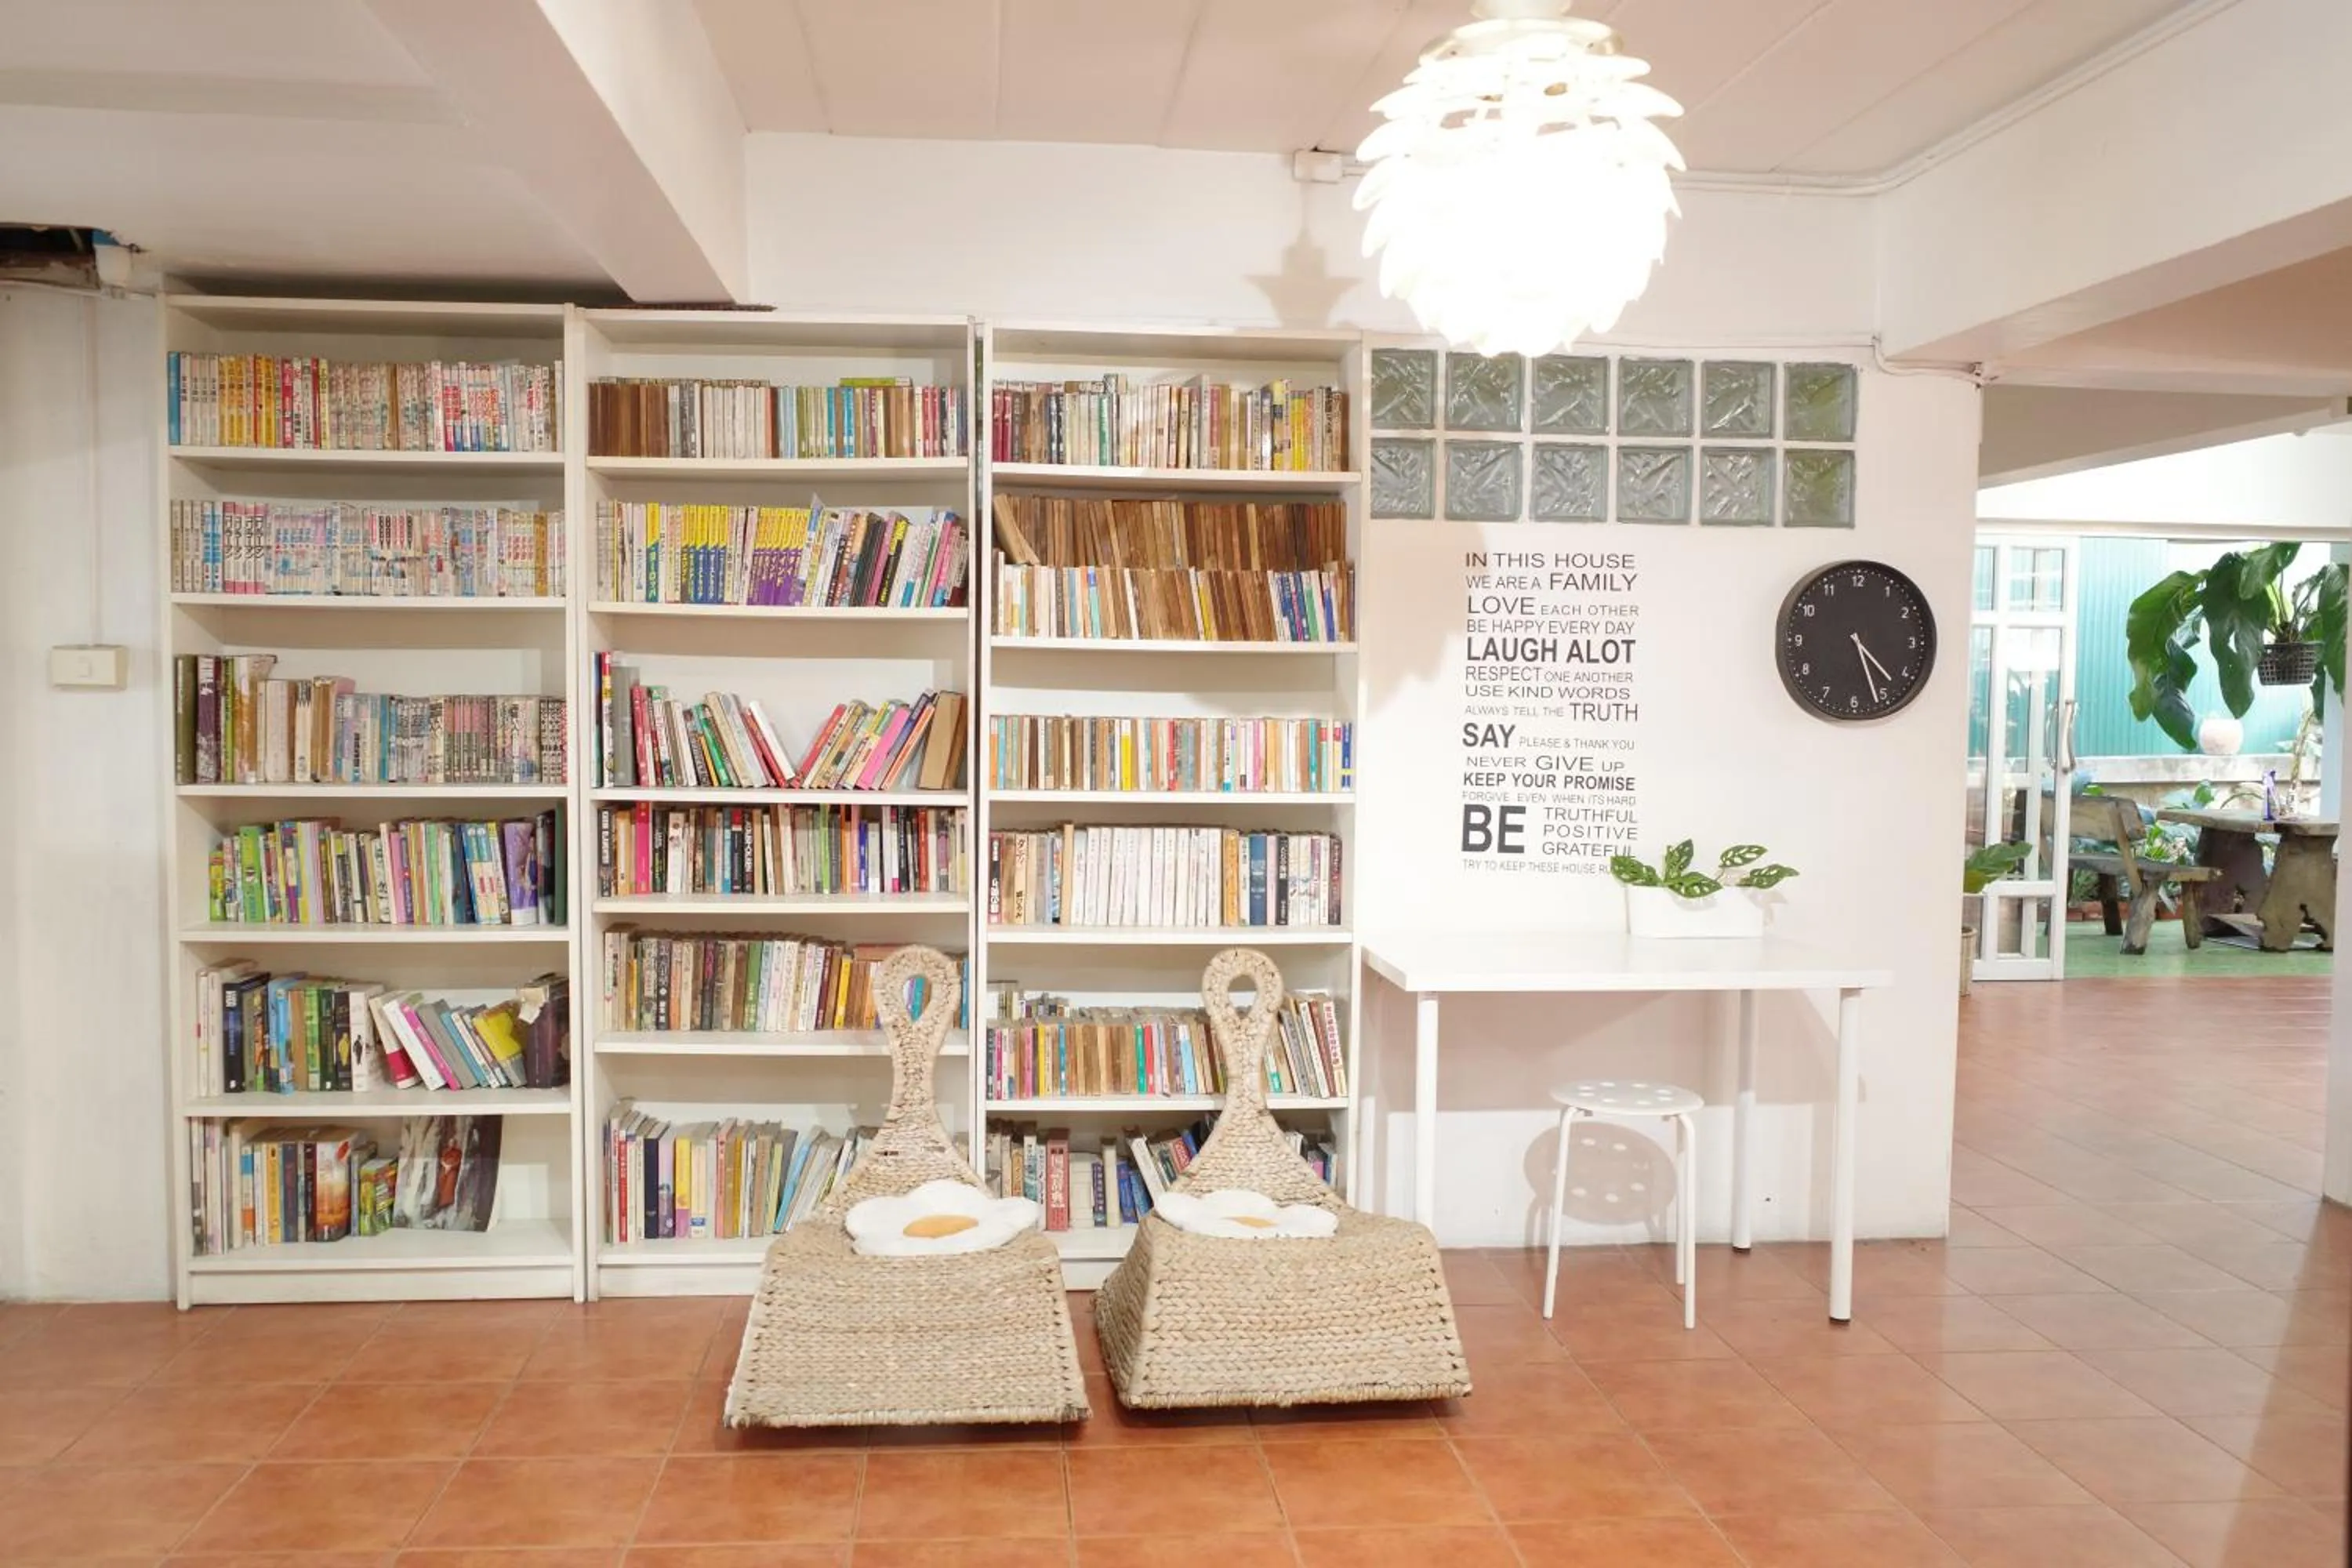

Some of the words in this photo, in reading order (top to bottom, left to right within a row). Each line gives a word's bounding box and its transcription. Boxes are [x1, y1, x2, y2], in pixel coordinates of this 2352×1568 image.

[1465, 553, 1487, 567] IN
[1493, 553, 1545, 568] THIS
[1555, 553, 1635, 569] HOUSE
[1466, 575, 1490, 589] WE
[1495, 576, 1527, 589] ARE
[1530, 577, 1541, 590] A
[1550, 572, 1638, 591] FAMILY
[1852, 575, 1864, 586] 12
[1824, 583, 1834, 596] 11
[1886, 586, 1890, 597] 1
[1468, 596, 1536, 615] LOVE
[1541, 604, 1581, 615] EACH
[1588, 605, 1639, 616] OTHER
[1804, 605, 1814, 616] 10
[1901, 608, 1909, 618] 2
[1468, 619, 1488, 633] BE
[1492, 619, 1544, 633] HAPPY
[1548, 620, 1600, 634] EVERY
[1606, 621, 1635, 634] DAY
[1795, 635, 1802, 646] 9
[1908, 637, 1915, 648] 3
[1467, 637, 1557, 662] LAUGH
[1566, 639, 1635, 663] ALOT
[1465, 666, 1542, 681] RESPECT
[1544, 671, 1570, 682] ONE
[1573, 672, 1633, 683] ANOTHER
[1802, 664, 1809, 674] 8
[1901, 666, 1908, 677] 4
[1465, 684, 1503, 697] USE
[1508, 685, 1553, 699] KIND
[1558, 687, 1630, 700] WORDS
[1823, 687, 1830, 698] 7
[1879, 688, 1887, 699] 5
[1850, 697, 1857, 707] 6
[1465, 705, 1508, 716] ALWAYS
[1514, 706, 1538, 717] TELL
[1543, 707, 1564, 717] THE
[1570, 703, 1639, 721] TRUTH
[1462, 722, 1515, 748] SAY
[1519, 736, 1560, 748] PLEASE
[1564, 739, 1570, 749] &
[1574, 738, 1609, 750] THANK
[1612, 739, 1635, 750] YOU
[1467, 757, 1526, 768] NEVER
[1536, 755, 1594, 771] GIVE
[1602, 761, 1624, 771] UP
[1464, 772, 1506, 786] KEEP
[1512, 773, 1556, 788] YOUR
[1564, 775, 1635, 790] PROMISE
[1462, 791, 1509, 802] FORGIVE
[1517, 793, 1546, 803] EVEN
[1552, 793, 1584, 804] WHEN
[1607, 795, 1636, 805] HARD
[1461, 804, 1526, 853] BE
[1544, 808, 1638, 823] TRUTHFUL
[1543, 824, 1638, 840] POSITIVE
[1542, 841, 1635, 858] GRATEFUL
[1463, 858, 1479, 870] TRY
[1484, 860, 1497, 870] TO
[1499, 861, 1525, 871] KEEP
[1528, 861, 1559, 872] THESE
[1562, 862, 1596, 873] HOUSE
